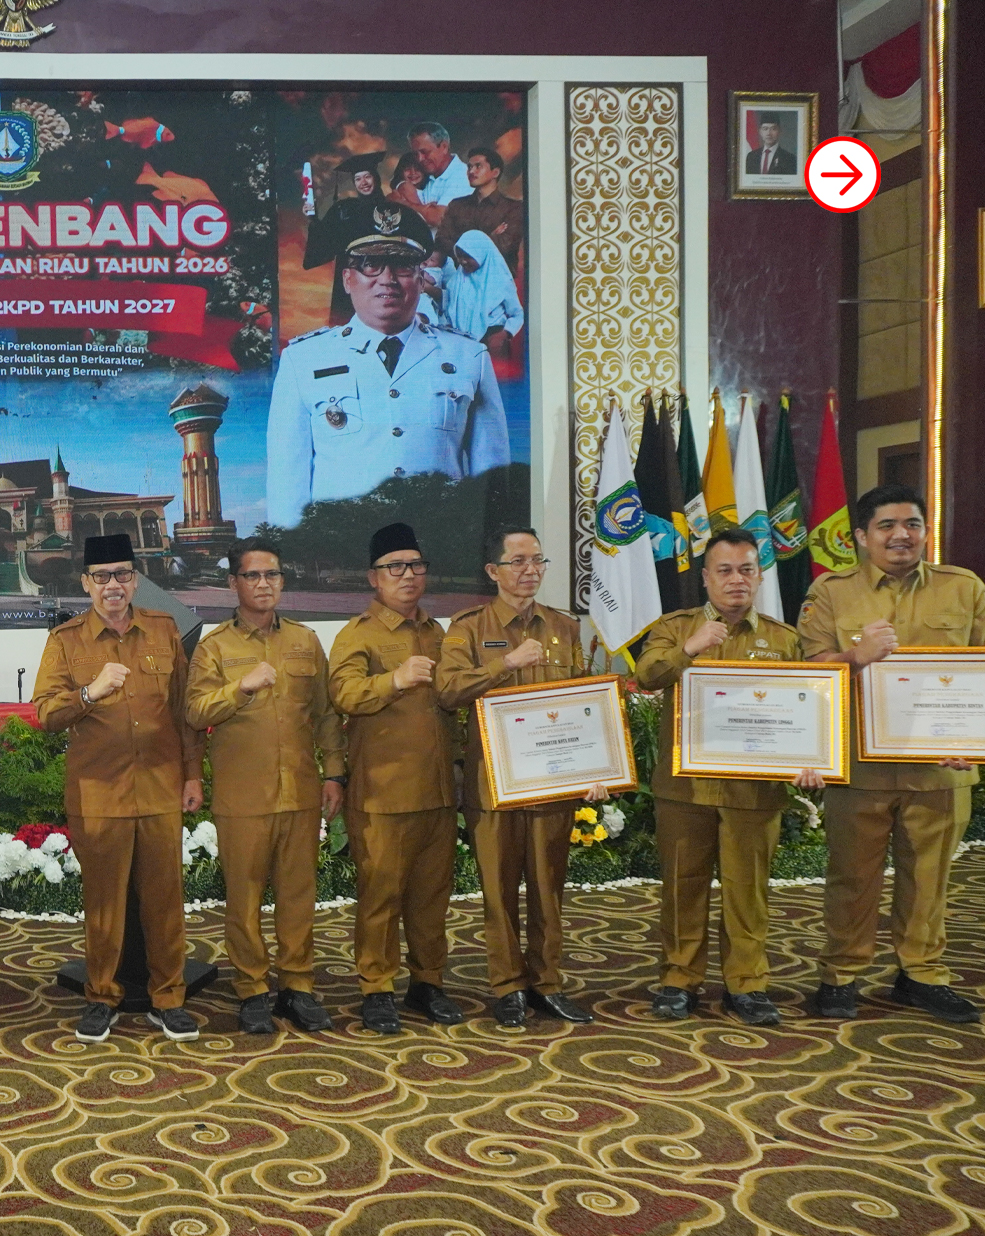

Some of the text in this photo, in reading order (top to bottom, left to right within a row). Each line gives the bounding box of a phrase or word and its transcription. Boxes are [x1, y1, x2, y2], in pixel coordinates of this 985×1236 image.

[39, 258, 89, 274] RIAU
[96, 257, 169, 273] TAHUN
[175, 257, 228, 273] 2026
[49, 300, 119, 314] TAHUN
[124, 299, 176, 314] 2027
[7, 341, 83, 352] Perekonomian
[85, 342, 122, 353] Daerah
[124, 345, 145, 354] dan
[58, 354, 78, 363] dan
[81, 355, 145, 367] Berkarakter,
[10, 366, 42, 375] Publik
[45, 368, 71, 377] yang
[598, 590, 619, 613] RIAU
